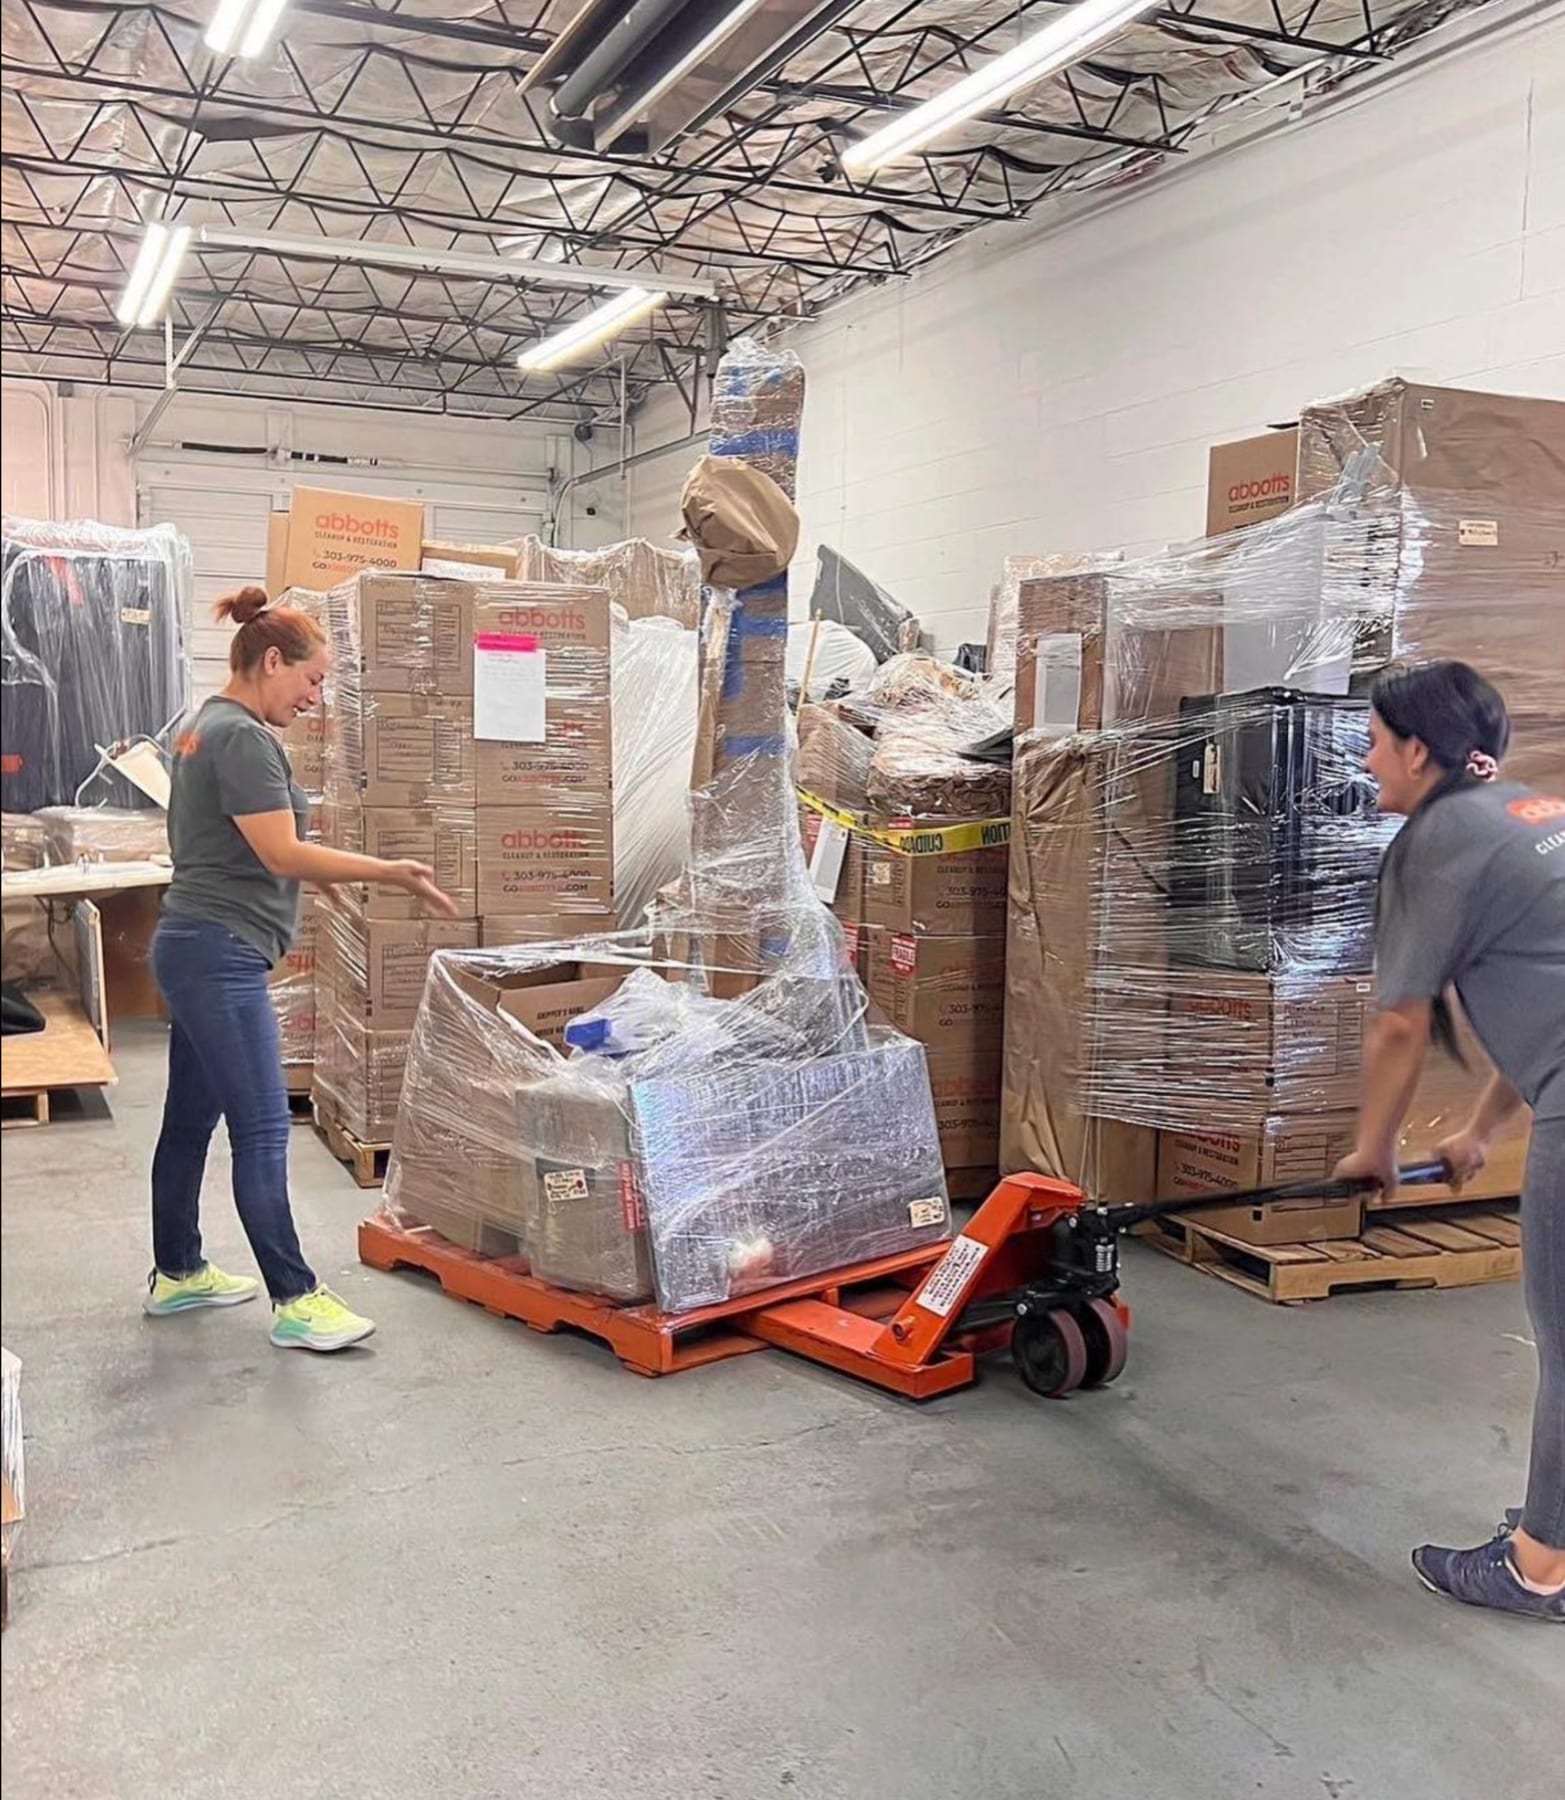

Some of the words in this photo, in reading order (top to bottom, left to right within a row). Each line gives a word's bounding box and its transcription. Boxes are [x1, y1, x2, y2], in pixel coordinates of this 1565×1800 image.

[315, 512, 400, 540] abbotts
[323, 551, 397, 568] 303-975-4000
[498, 607, 585, 630] abbotts
